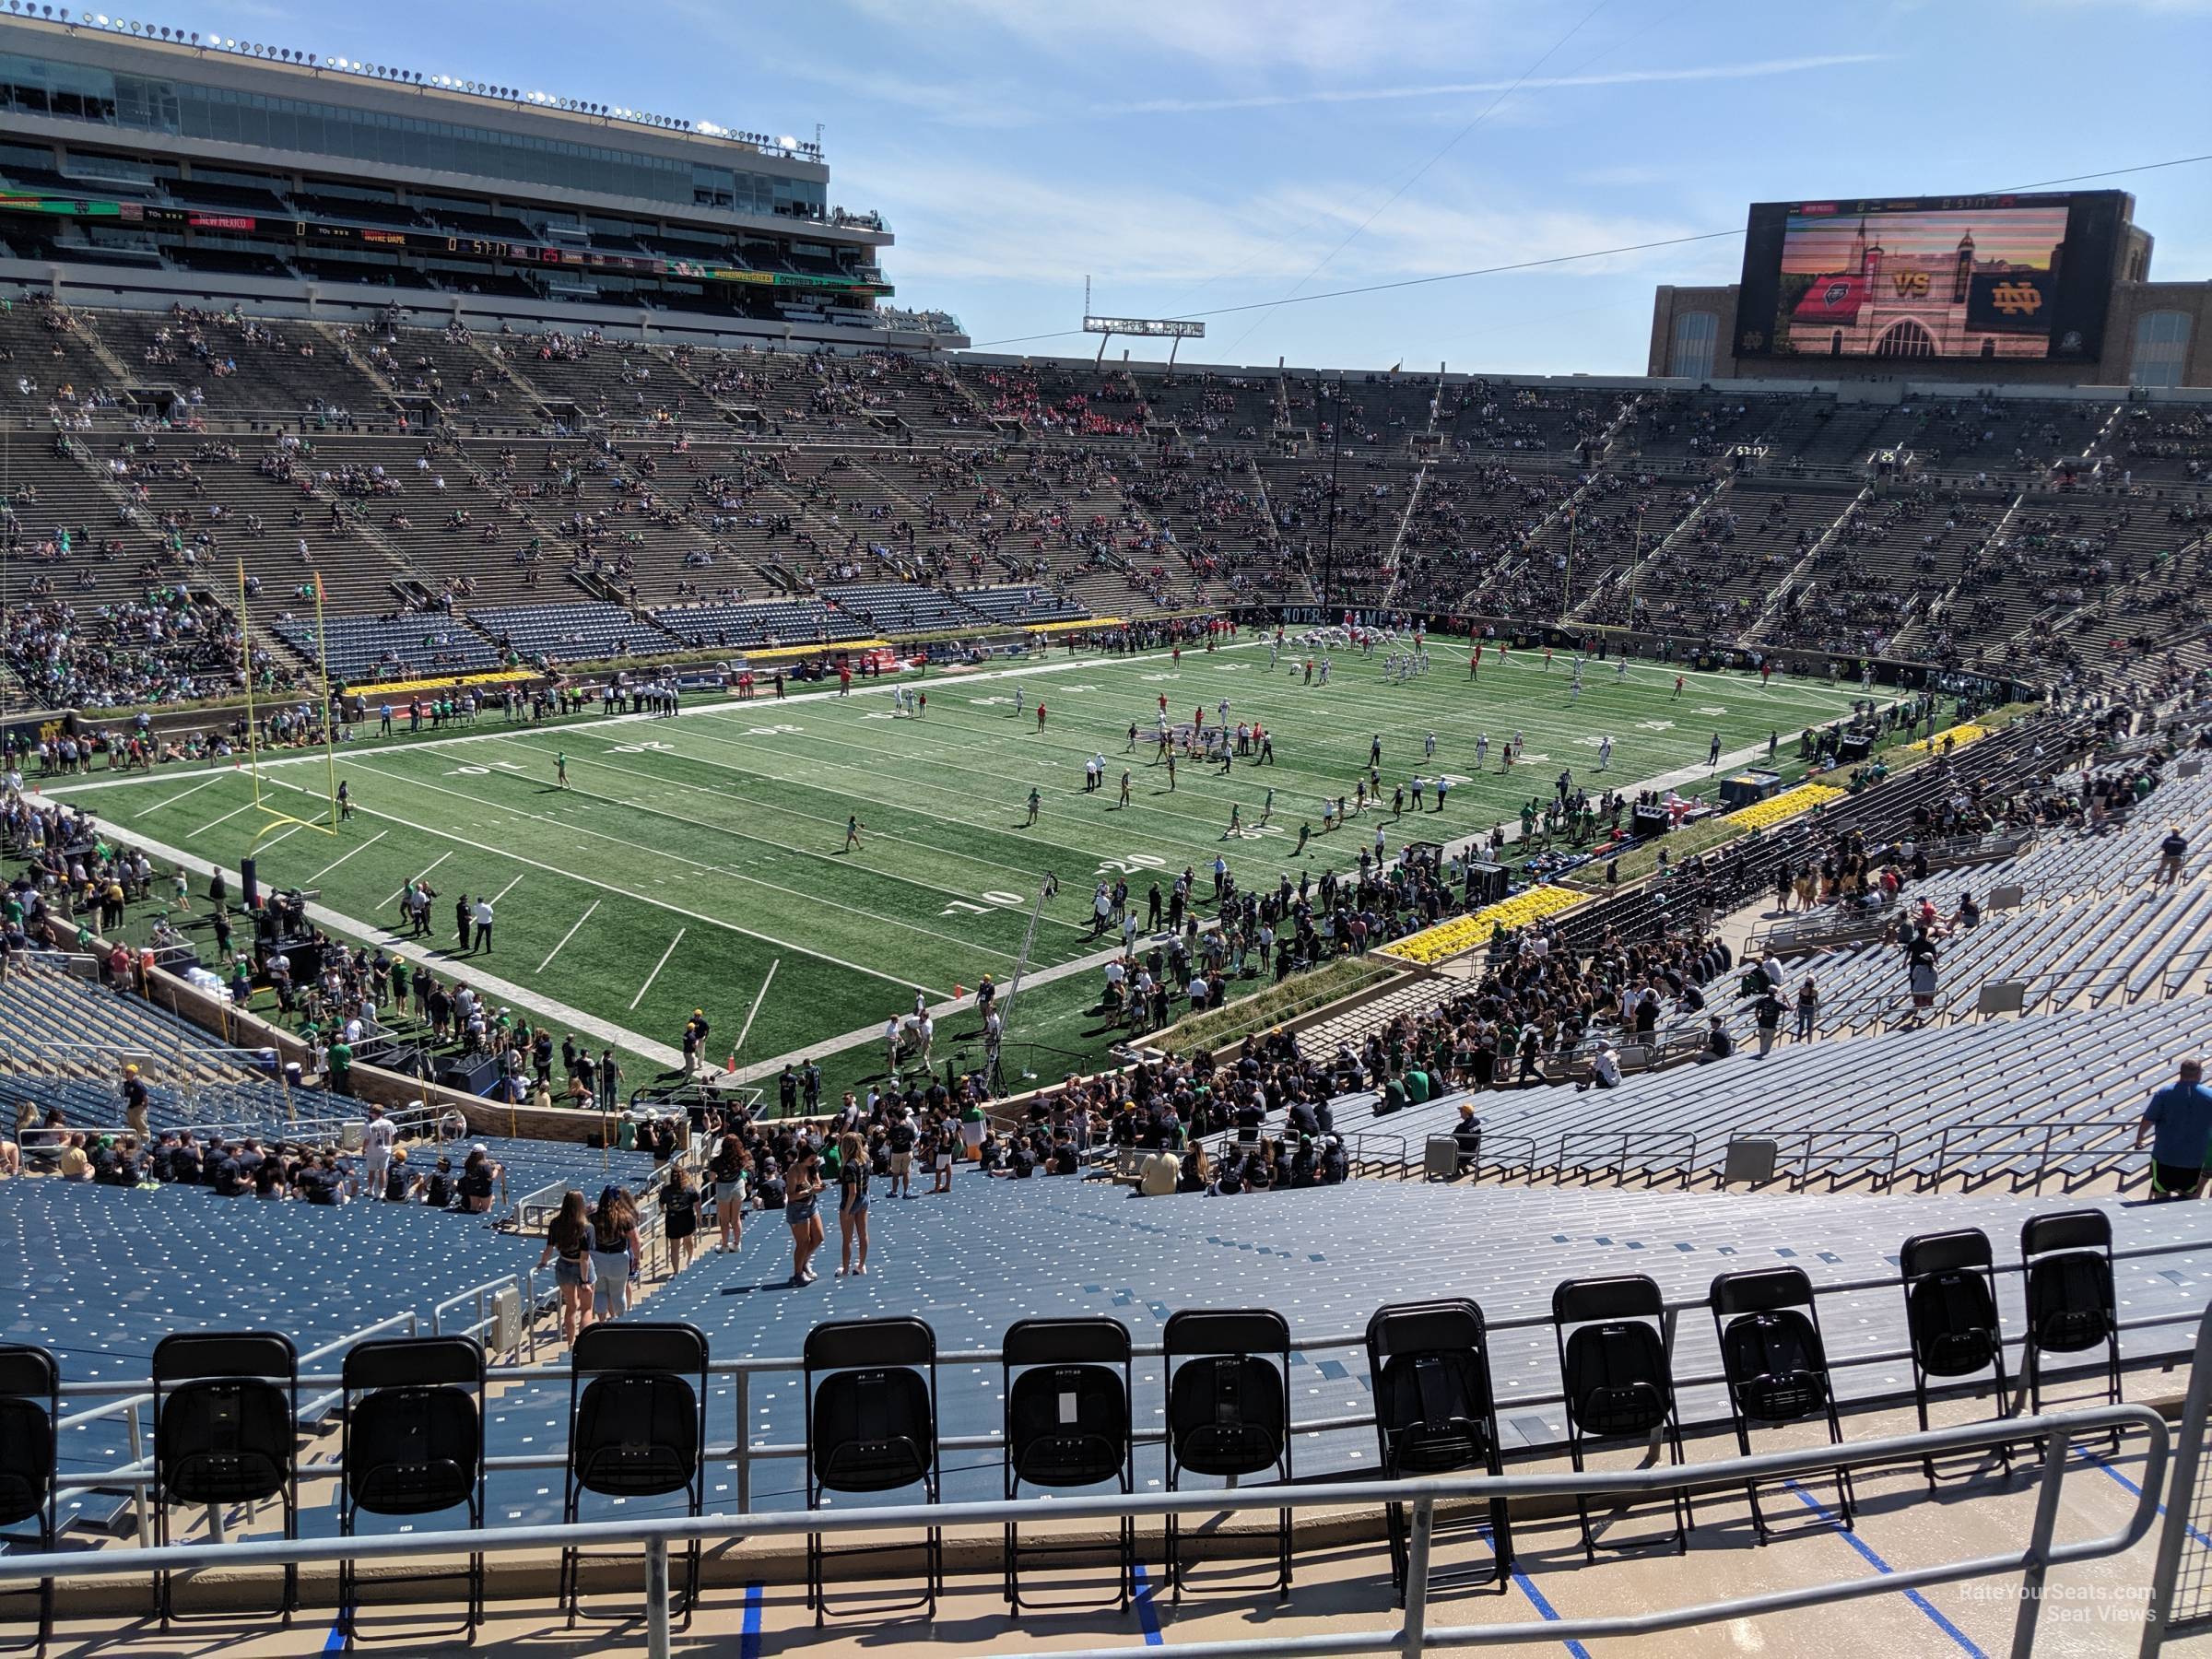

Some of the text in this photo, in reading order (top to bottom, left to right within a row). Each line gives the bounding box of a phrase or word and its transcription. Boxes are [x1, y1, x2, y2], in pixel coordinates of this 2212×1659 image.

[199, 213, 246, 229] NEW MEXICO
[364, 230, 406, 245] NOTRE DAME
[474, 240, 508, 257] 57:17
[543, 248, 559, 263] 25
[1894, 270, 1930, 296] VS
[1736, 446, 1764, 455] 57:17
[1881, 451, 1895, 462] 25
[750, 724, 805, 735] 30
[614, 741, 676, 754] 20
[457, 760, 527, 776] 10
[1099, 853, 1167, 875] 20
[946, 890, 1024, 915] 10
[322, 947, 333, 957] 25
